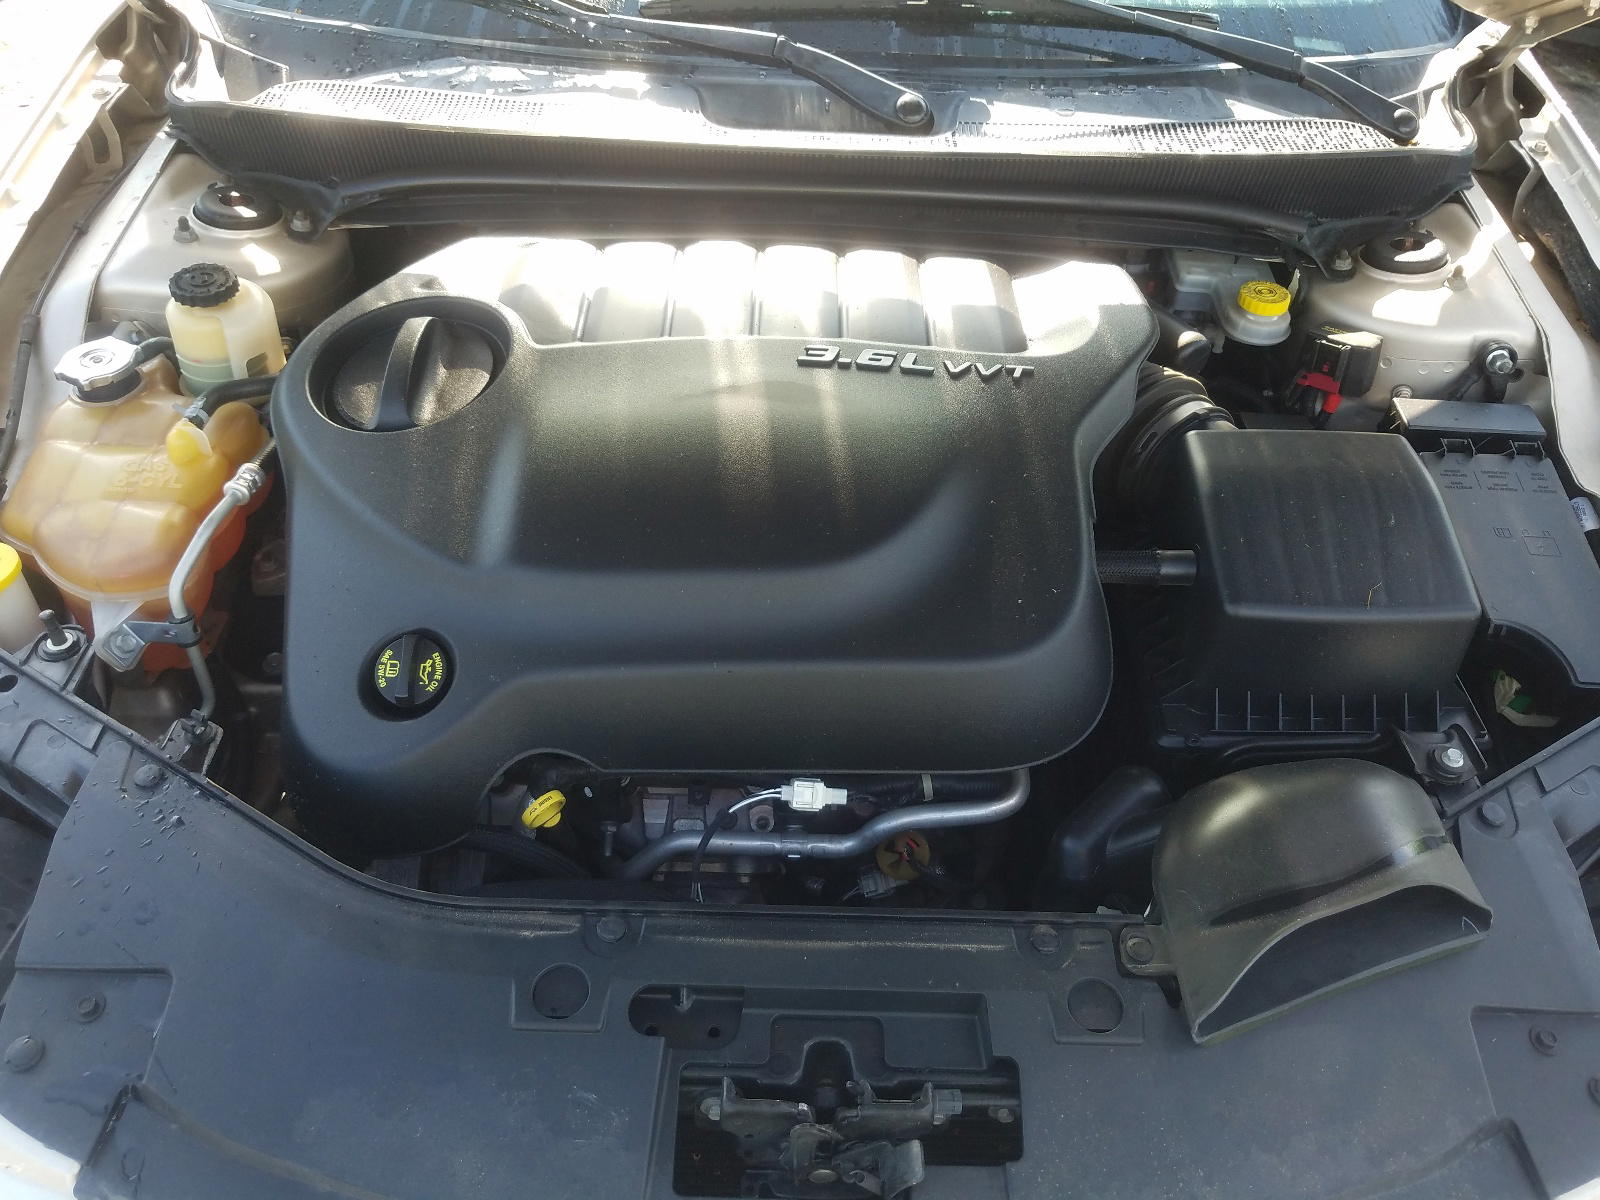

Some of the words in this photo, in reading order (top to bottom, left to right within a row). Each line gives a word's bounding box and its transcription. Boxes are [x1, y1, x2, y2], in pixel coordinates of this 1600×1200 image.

[797, 344, 935, 375] 3.6L
[943, 359, 1035, 382] VVT
[380, 649, 393, 663] SAE
[432, 652, 443, 680] ENGINE
[425, 681, 438, 692] OIL
